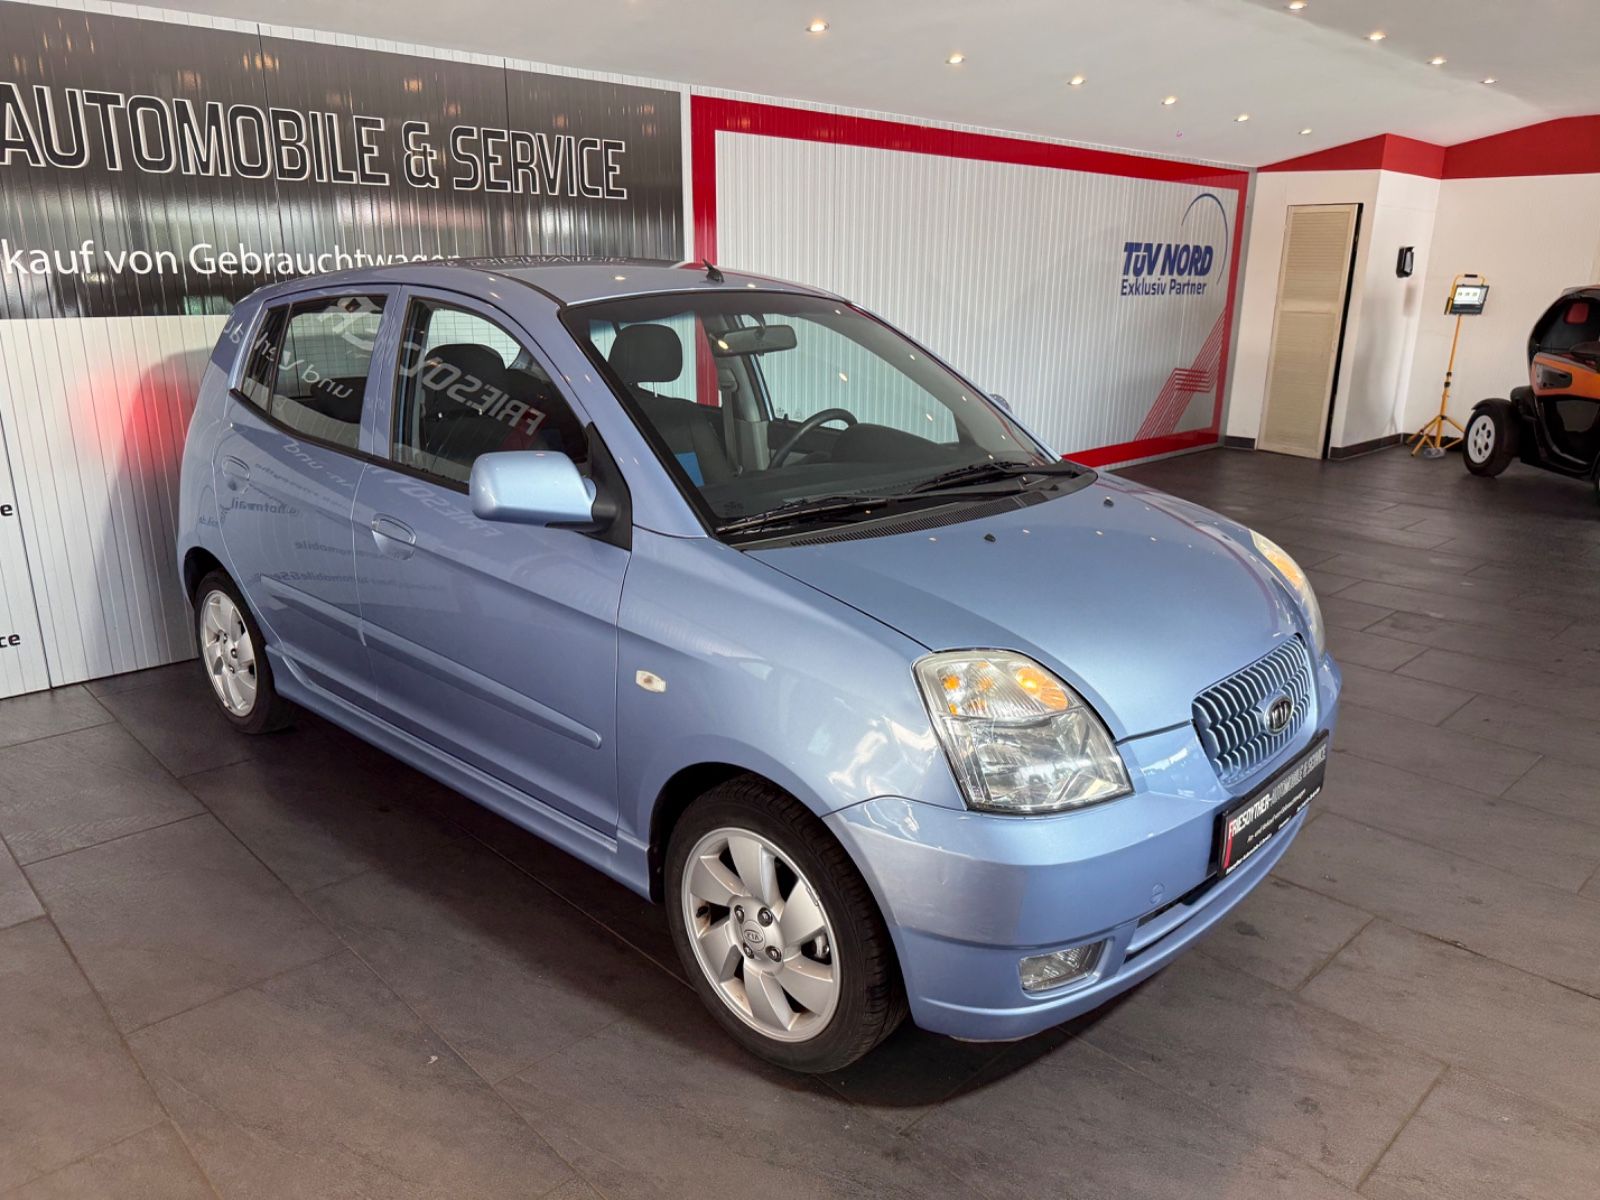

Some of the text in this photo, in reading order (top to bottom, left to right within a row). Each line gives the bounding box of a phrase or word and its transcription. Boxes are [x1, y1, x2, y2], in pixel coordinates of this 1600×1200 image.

[0, 81, 628, 199] AUTOMOBILE & SERVICE
[1, 239, 95, 275] kauf
[104, 250, 178, 275] von
[1160, 243, 1213, 277] NORD
[1121, 277, 1207, 296] Exklusiv Partner
